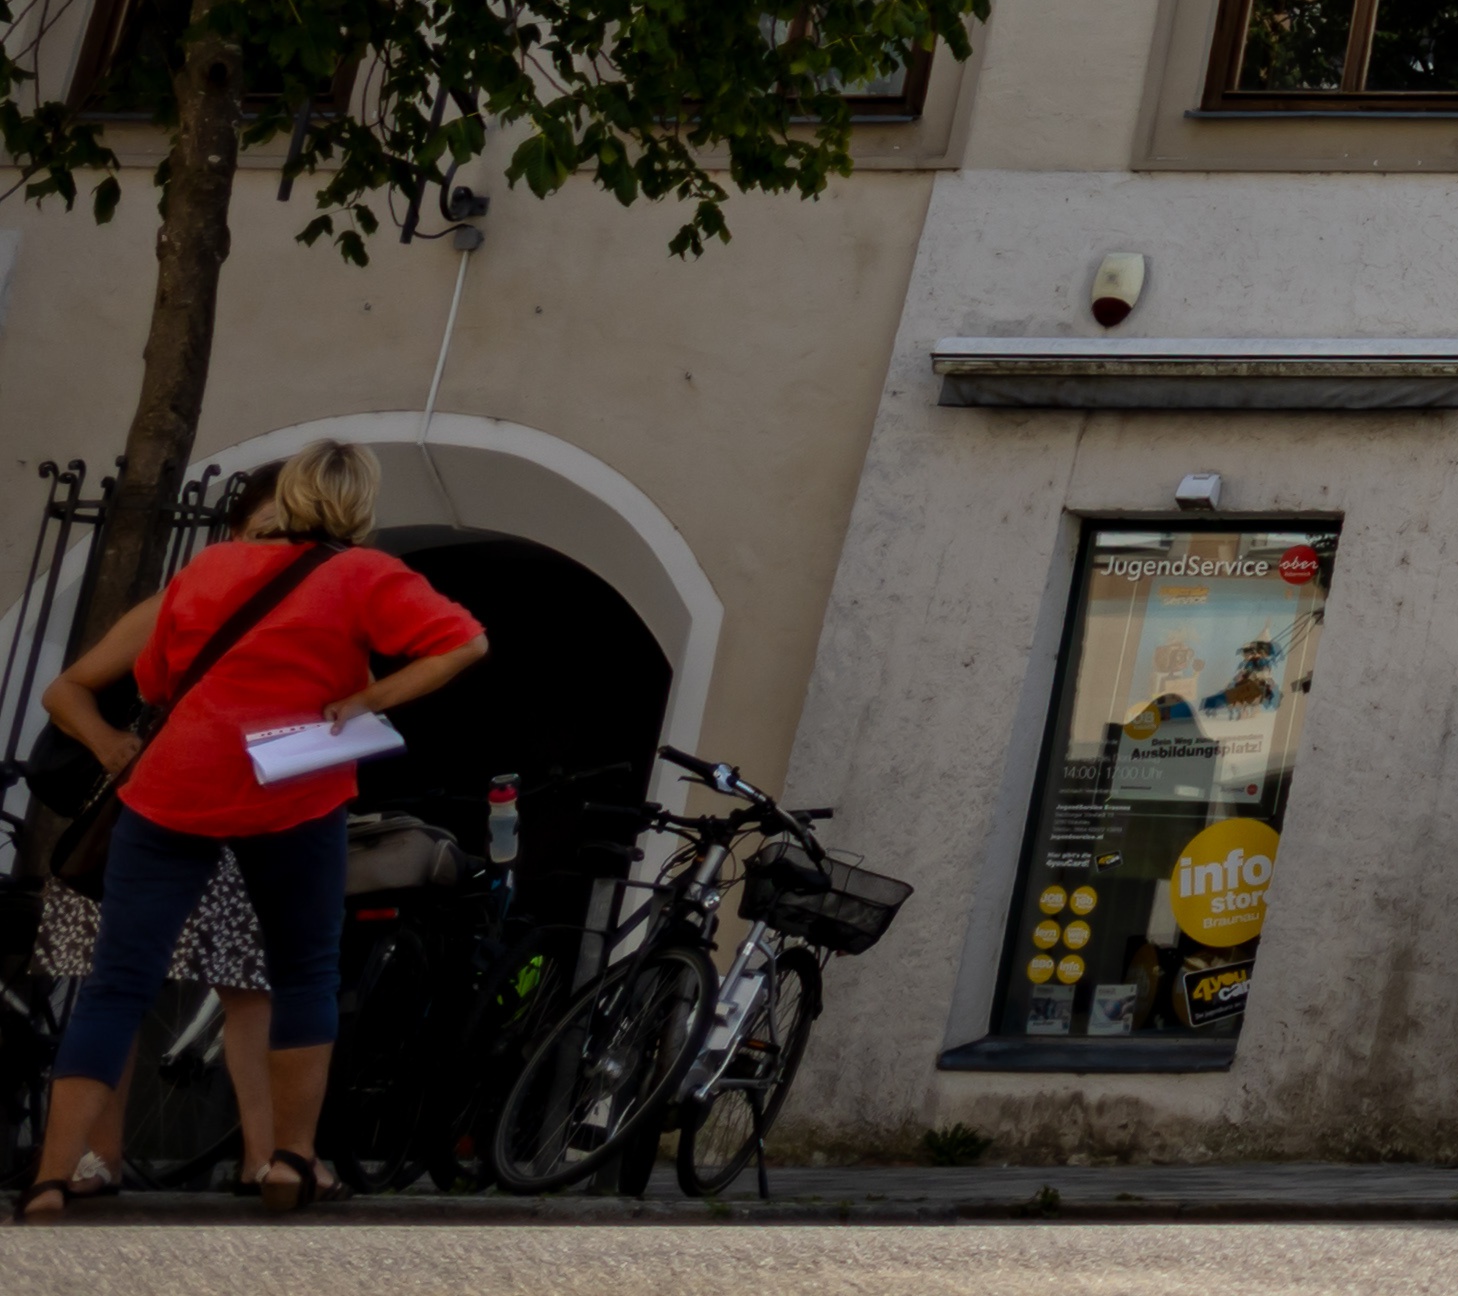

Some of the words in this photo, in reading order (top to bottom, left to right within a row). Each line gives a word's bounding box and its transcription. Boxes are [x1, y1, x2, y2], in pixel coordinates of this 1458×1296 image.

[1100, 554, 1269, 581] JugendService
[1131, 740, 1263, 760] Ausbildungsplatz!
[1180, 848, 1272, 898] info
[1203, 912, 1260, 929] Braunau
[1192, 969, 1247, 1001] 4you
